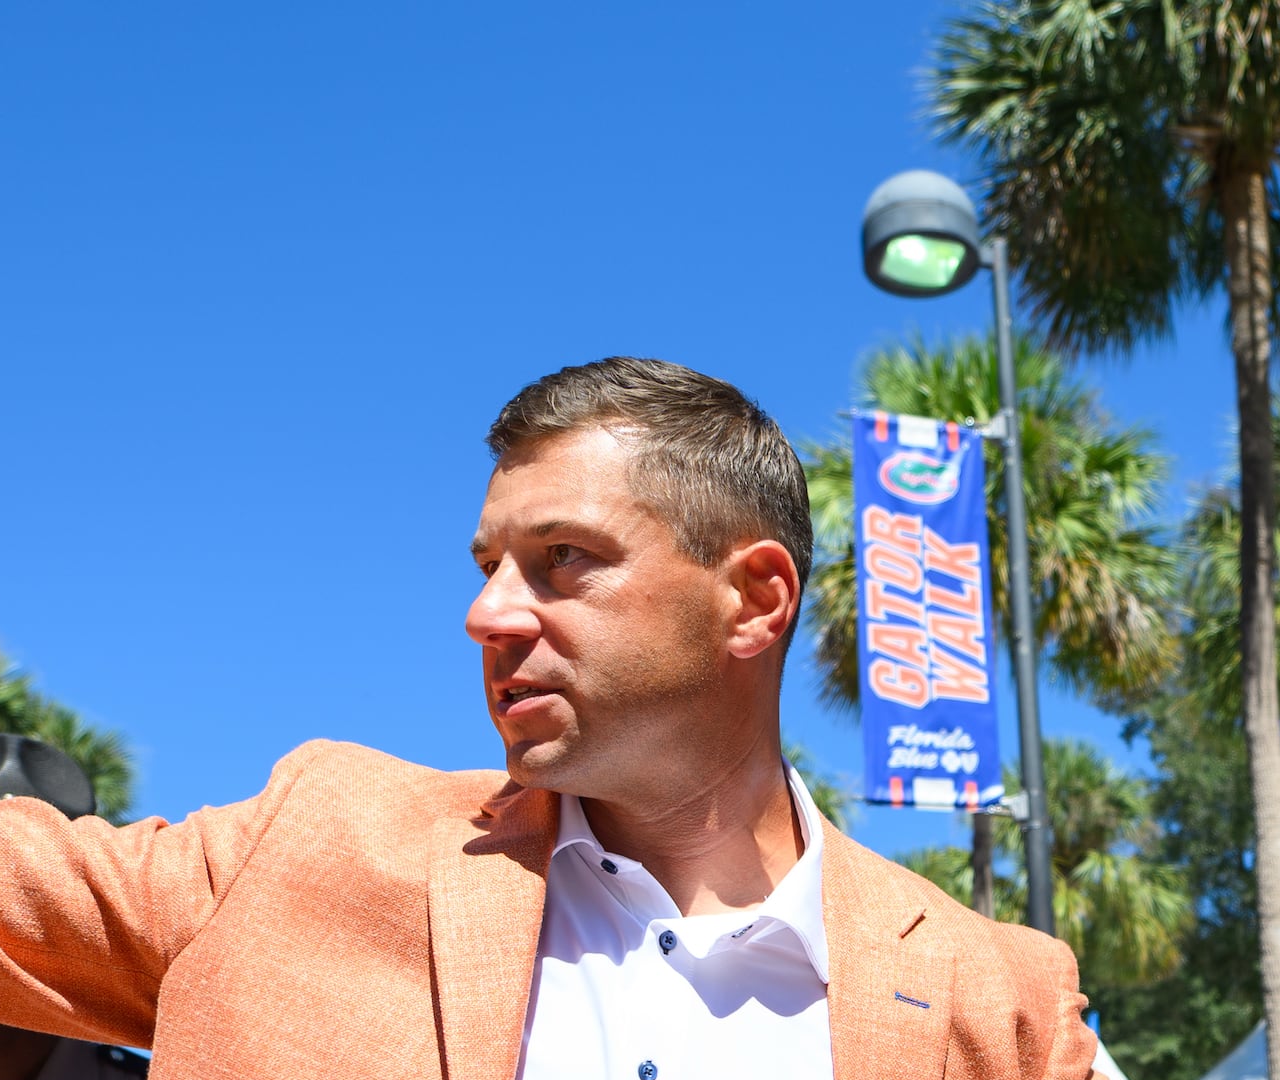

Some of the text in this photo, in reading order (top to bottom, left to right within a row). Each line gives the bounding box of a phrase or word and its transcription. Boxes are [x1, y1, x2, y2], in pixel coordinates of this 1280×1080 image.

[862, 504, 930, 710] GATOR
[923, 525, 990, 704] WALK
[887, 722, 975, 751] Florida
[887, 746, 939, 770] Blue
